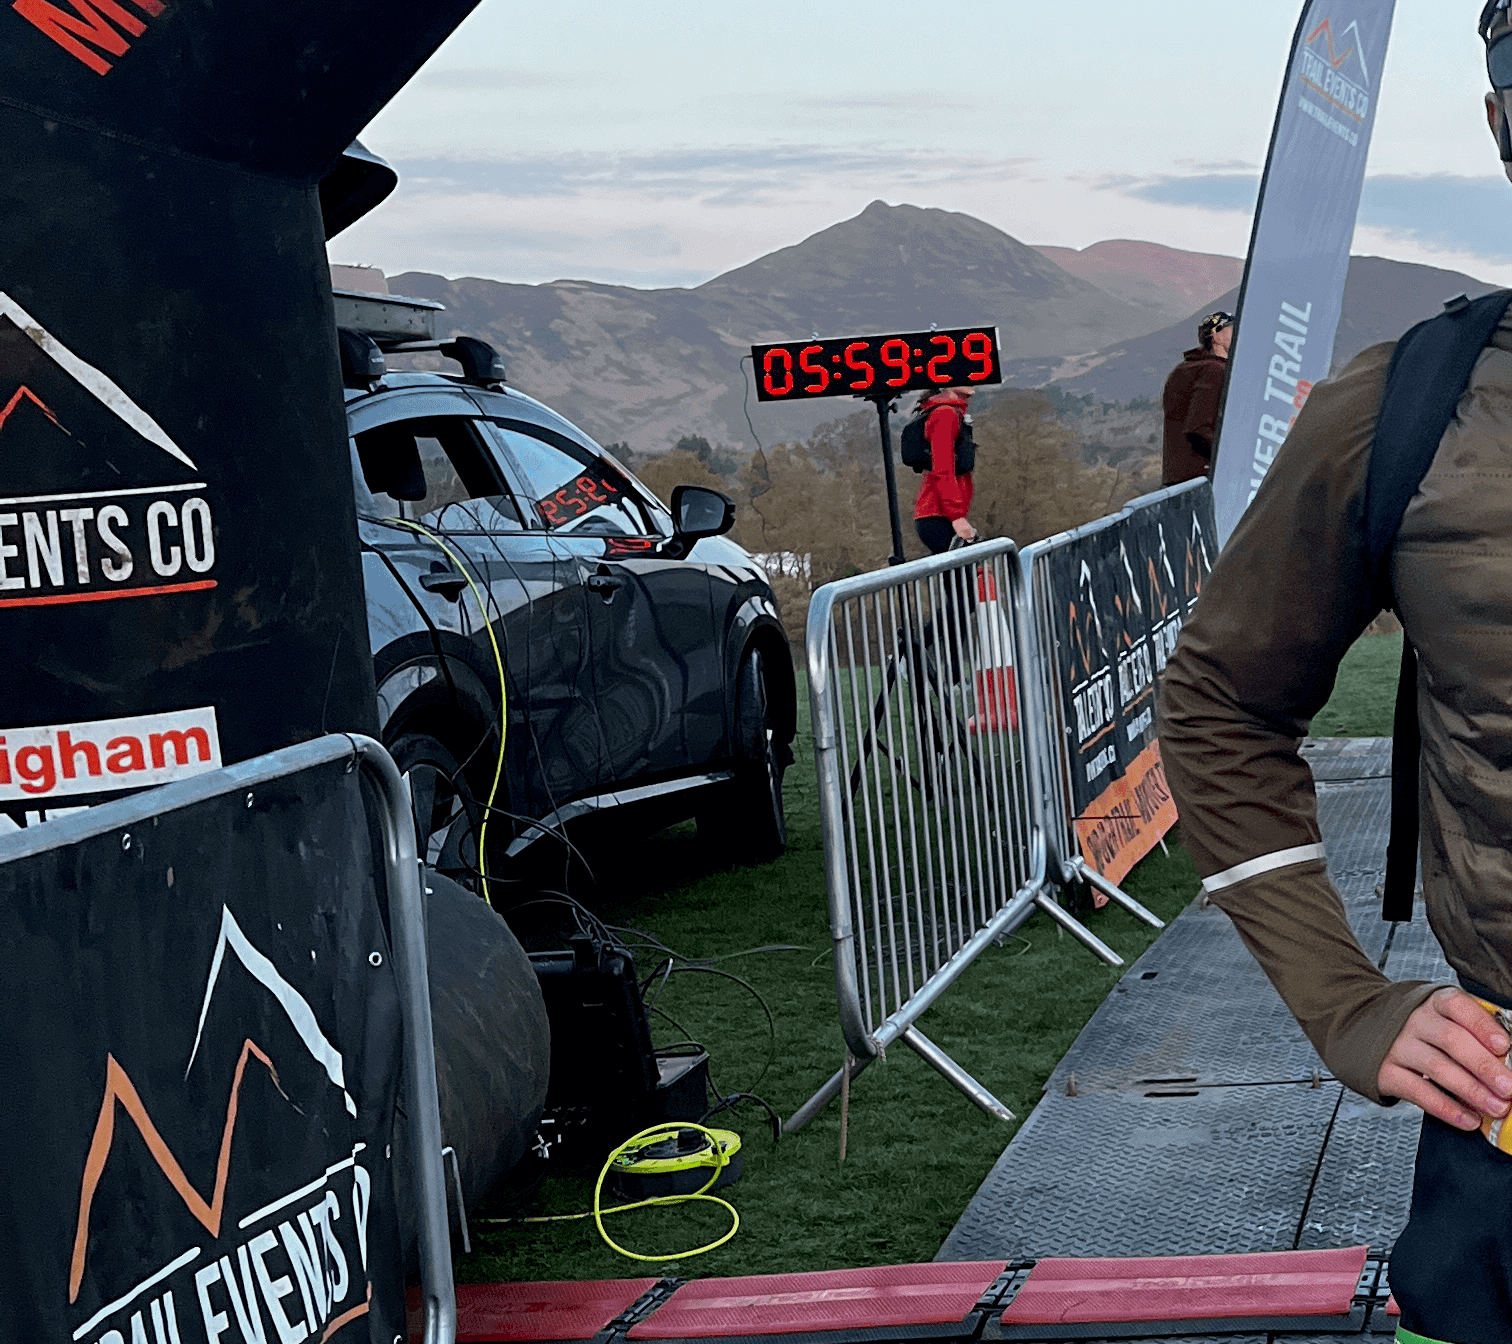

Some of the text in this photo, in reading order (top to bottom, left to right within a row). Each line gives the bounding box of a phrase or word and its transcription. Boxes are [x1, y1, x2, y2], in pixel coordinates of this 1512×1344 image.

[763, 332, 993, 396] 05:59:29
[1264, 301, 1312, 405] TRAIL
[147, 497, 215, 577] CO
